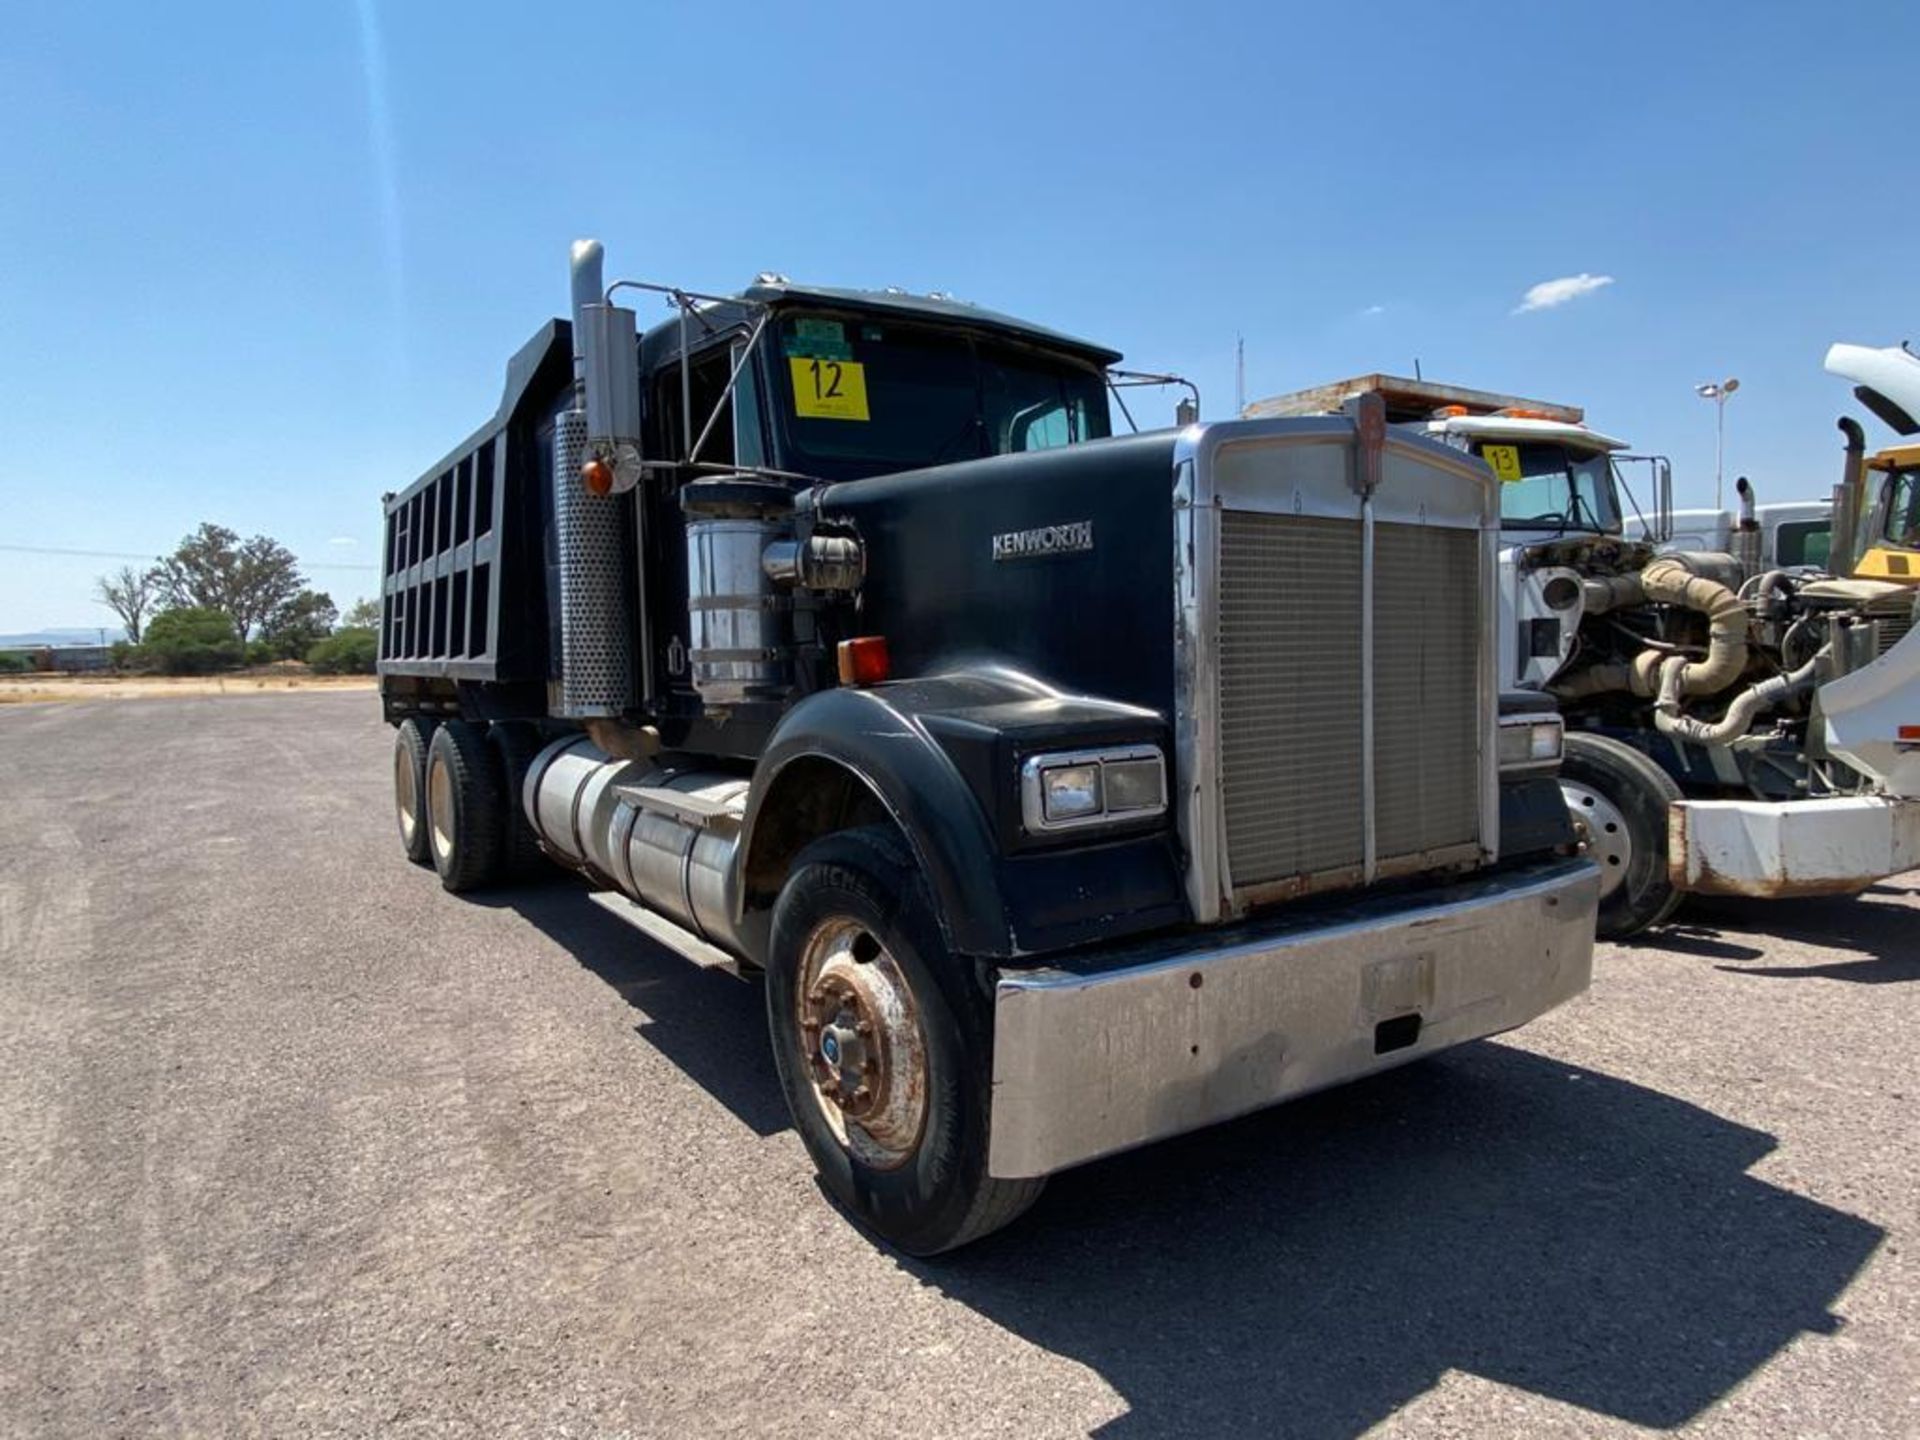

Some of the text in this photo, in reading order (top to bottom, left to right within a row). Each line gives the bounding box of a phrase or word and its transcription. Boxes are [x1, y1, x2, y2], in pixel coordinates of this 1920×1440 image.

[810, 360, 843, 400] 12
[1492, 447, 1514, 470] 13
[993, 521, 1093, 560] KENWORTH
